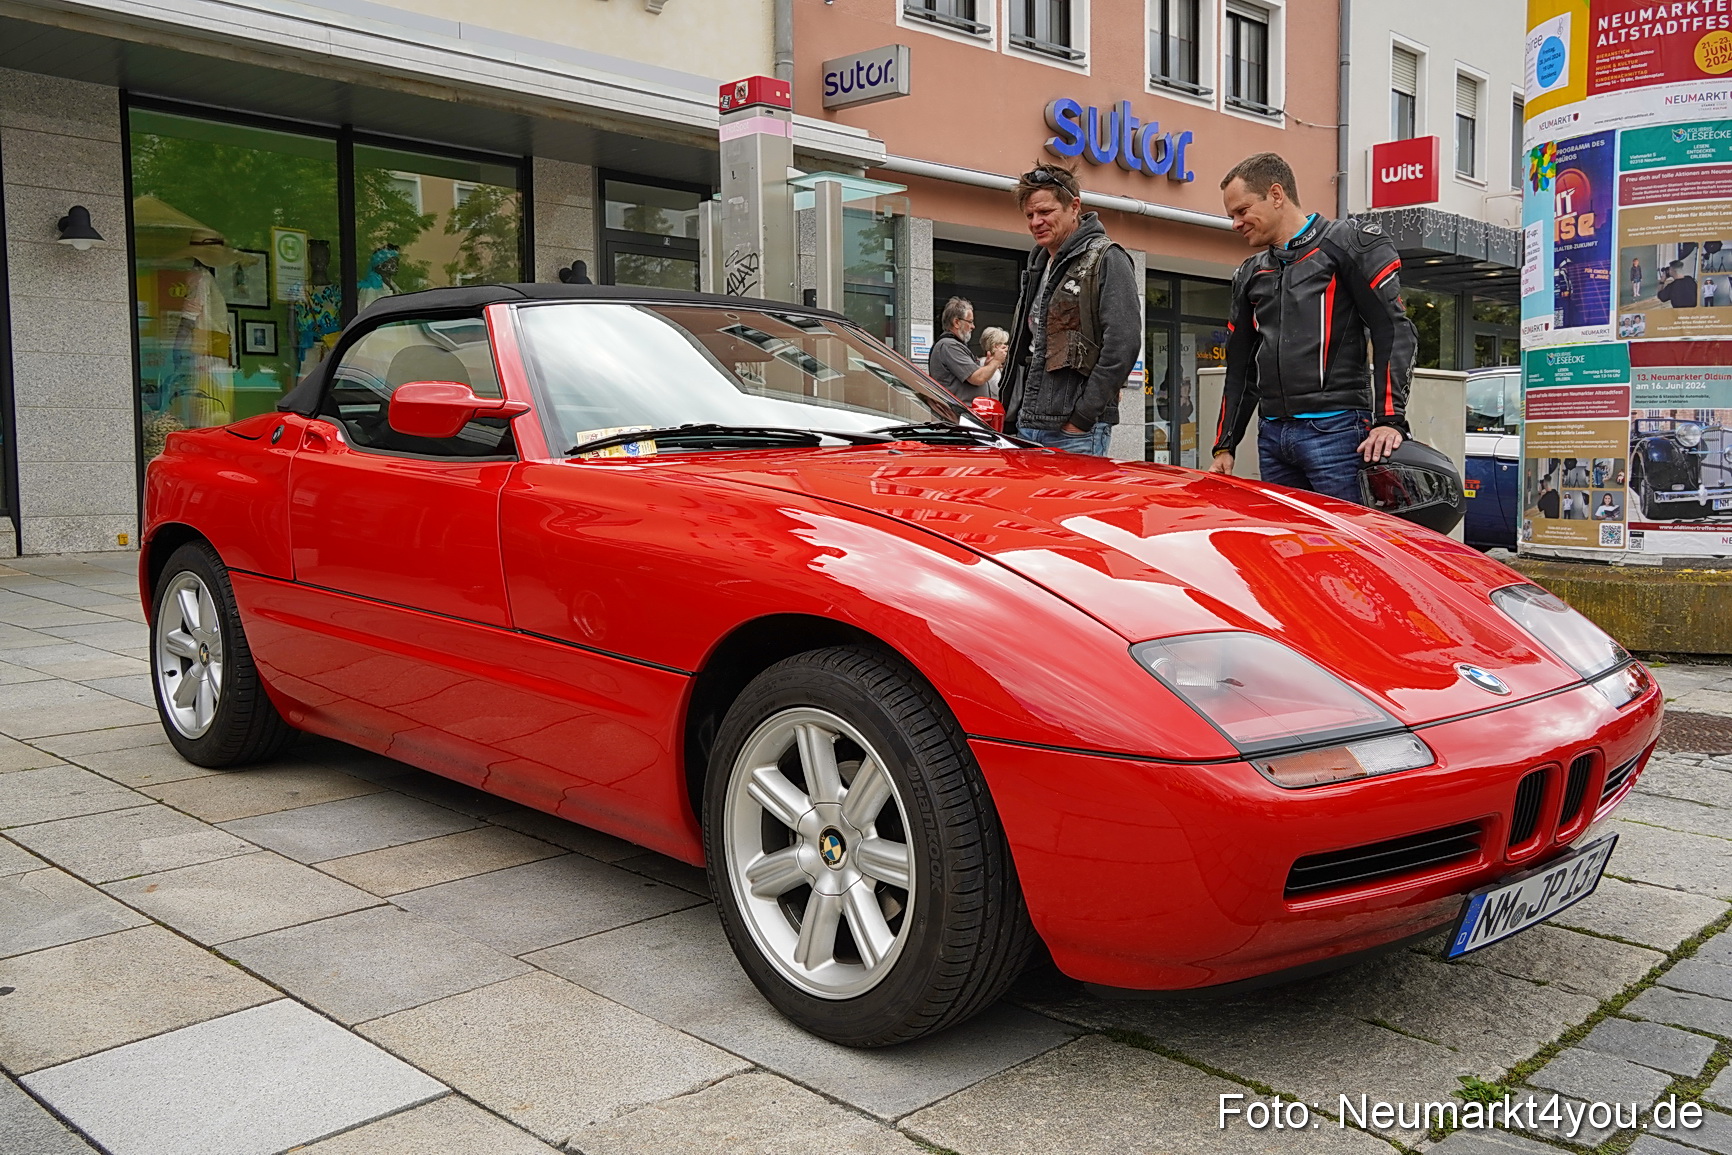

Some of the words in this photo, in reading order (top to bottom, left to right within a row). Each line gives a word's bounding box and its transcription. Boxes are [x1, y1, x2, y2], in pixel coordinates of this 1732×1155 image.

[1598, 0, 1732, 31] NEUMARKTE
[1597, 14, 1732, 47] ALTSTADTFES
[1665, 90, 1728, 105] NEUMARKT
[1538, 114, 1571, 131] NEUMARKT
[1686, 130, 1732, 141] LESEECKE
[1637, 373, 1648, 381] 13.
[1650, 373, 1702, 381] Neumarkter
[1651, 382, 1664, 390] 16.
[1665, 382, 1684, 390] Juni
[1686, 382, 1706, 390] 2024
[1471, 886, 1523, 943] NM
[1526, 867, 1568, 920] JP
[1456, 931, 1466, 946] D
